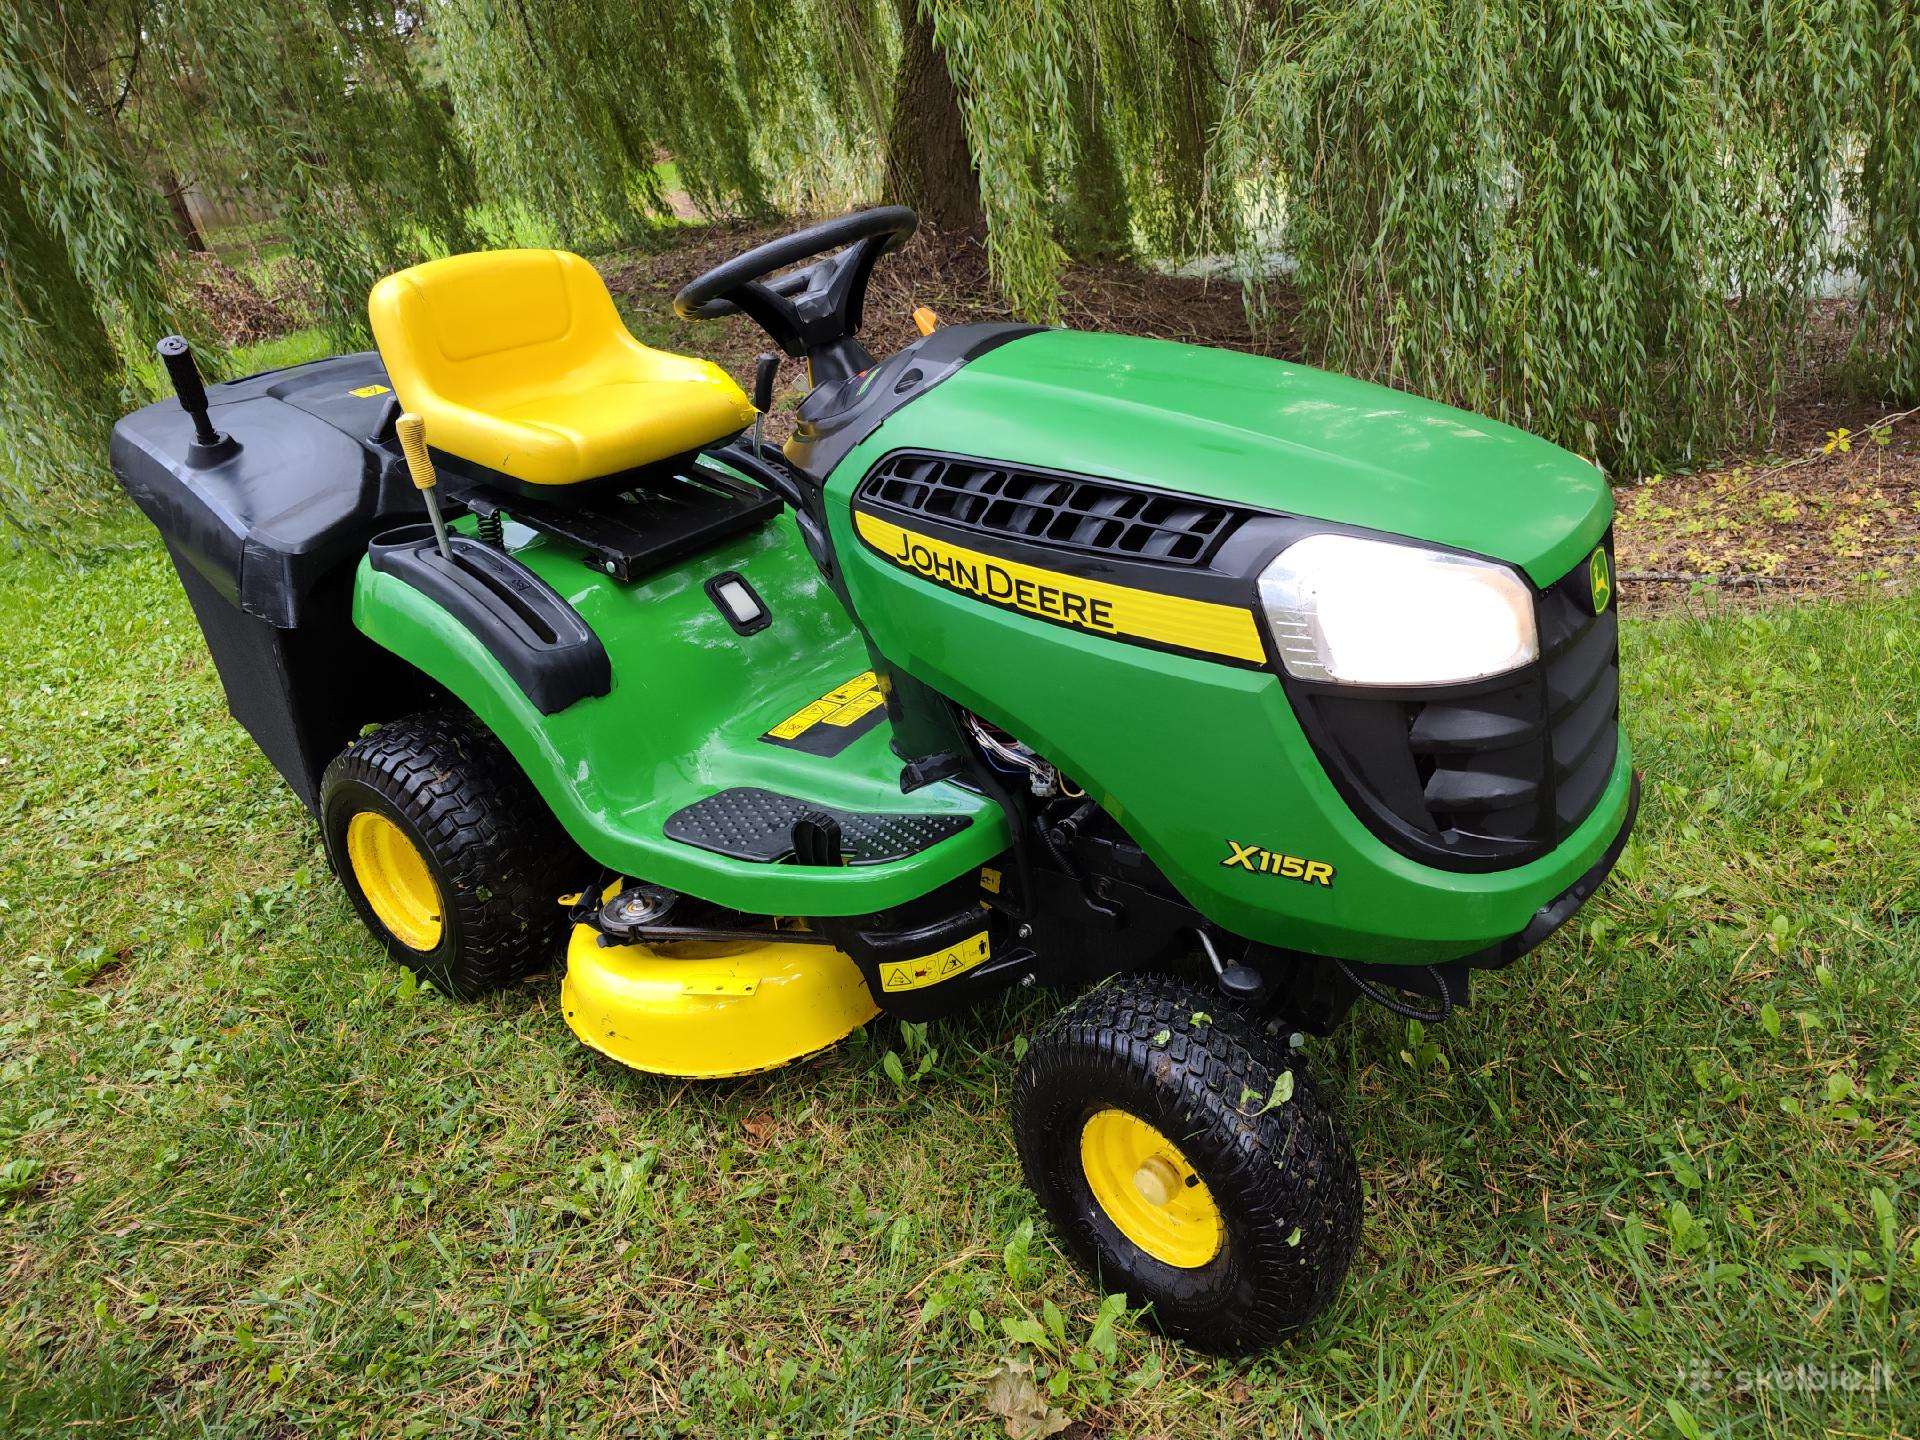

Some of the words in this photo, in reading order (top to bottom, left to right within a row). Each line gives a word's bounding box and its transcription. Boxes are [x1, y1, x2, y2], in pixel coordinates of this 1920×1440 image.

[897, 533, 979, 590] JOHN
[985, 563, 1115, 629] DEERE
[1221, 840, 1335, 888] X115R
